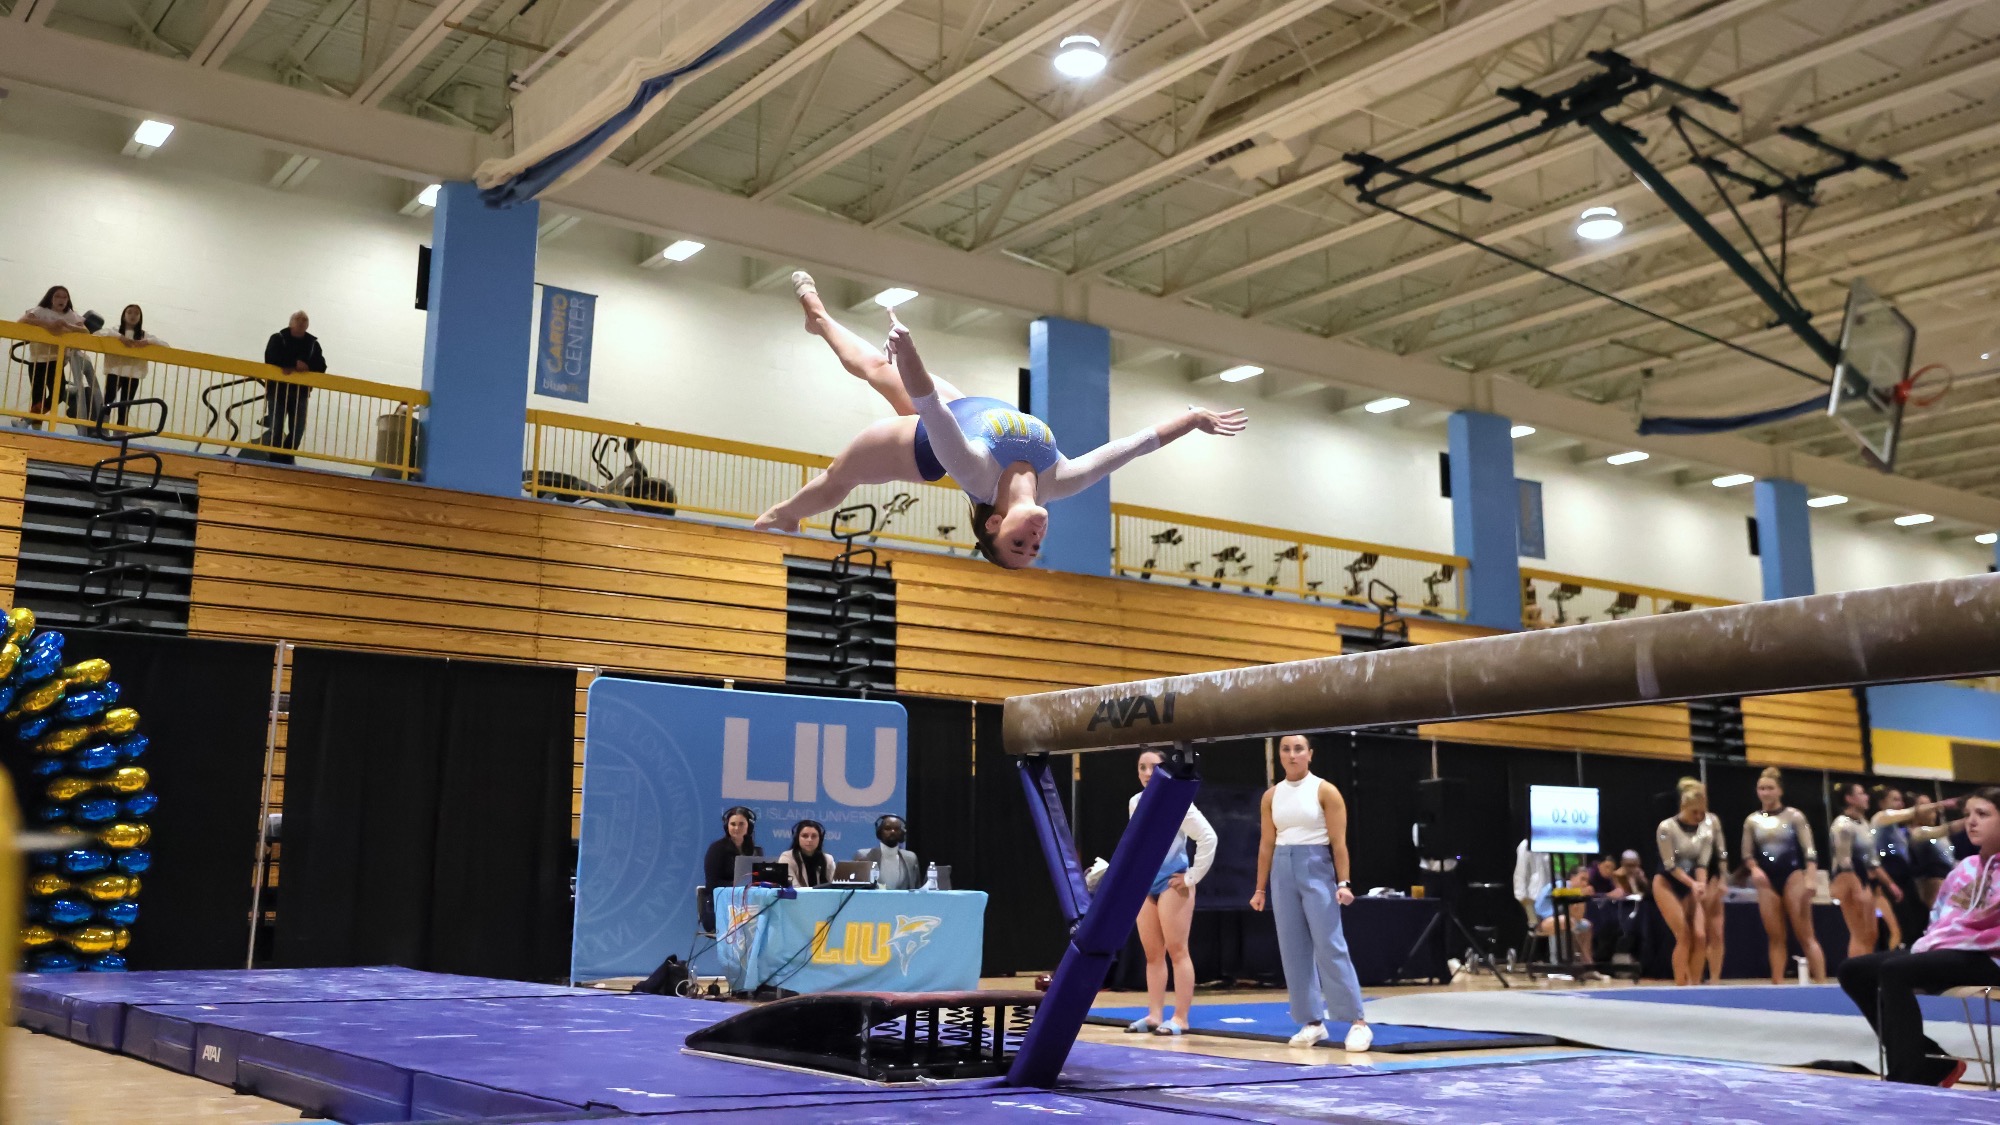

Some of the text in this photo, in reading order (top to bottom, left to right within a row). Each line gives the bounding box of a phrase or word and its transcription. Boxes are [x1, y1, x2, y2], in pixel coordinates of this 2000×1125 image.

[546, 293, 568, 374] CARDIO
[564, 297, 586, 376] CENTER
[721, 717, 897, 807] LIU
[767, 807, 815, 820] ISLAND
[812, 921, 892, 967] LIU
